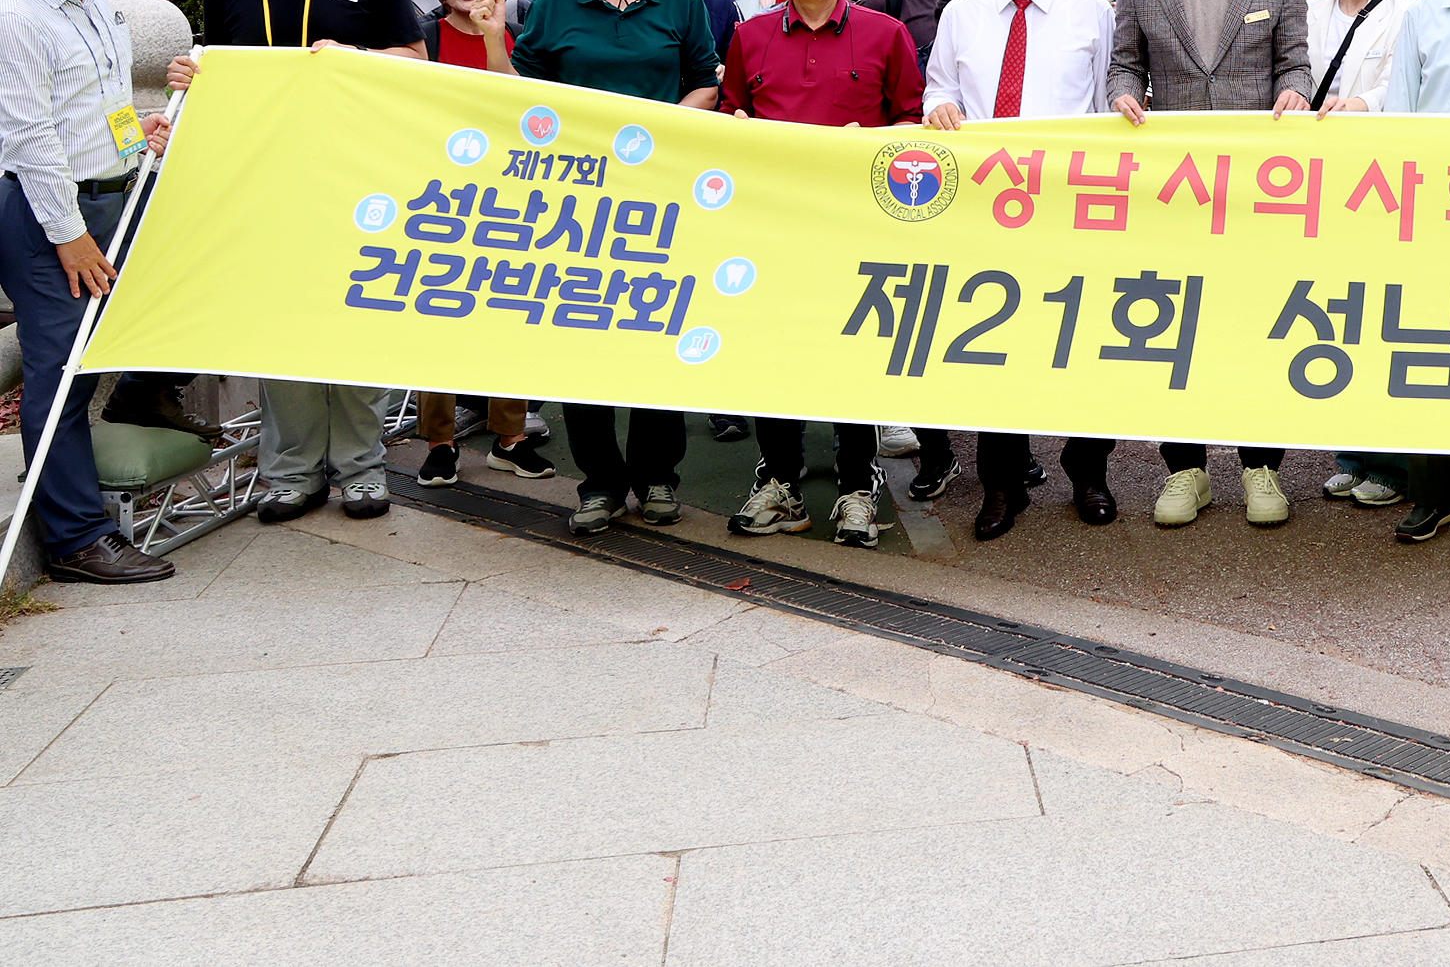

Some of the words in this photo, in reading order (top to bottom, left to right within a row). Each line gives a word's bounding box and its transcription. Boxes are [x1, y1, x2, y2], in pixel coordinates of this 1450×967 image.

[502, 149, 608, 188] 제17회
[882, 142, 950, 162] 성남시의사회
[404, 179, 681, 264] 성남시민
[873, 165, 893, 210] SEONGNAM
[892, 203, 927, 221] MEDICAL
[927, 168, 958, 217] ASSOCIATION
[344, 245, 697, 336] 건강박람회
[840, 261, 1204, 391] 제21회
